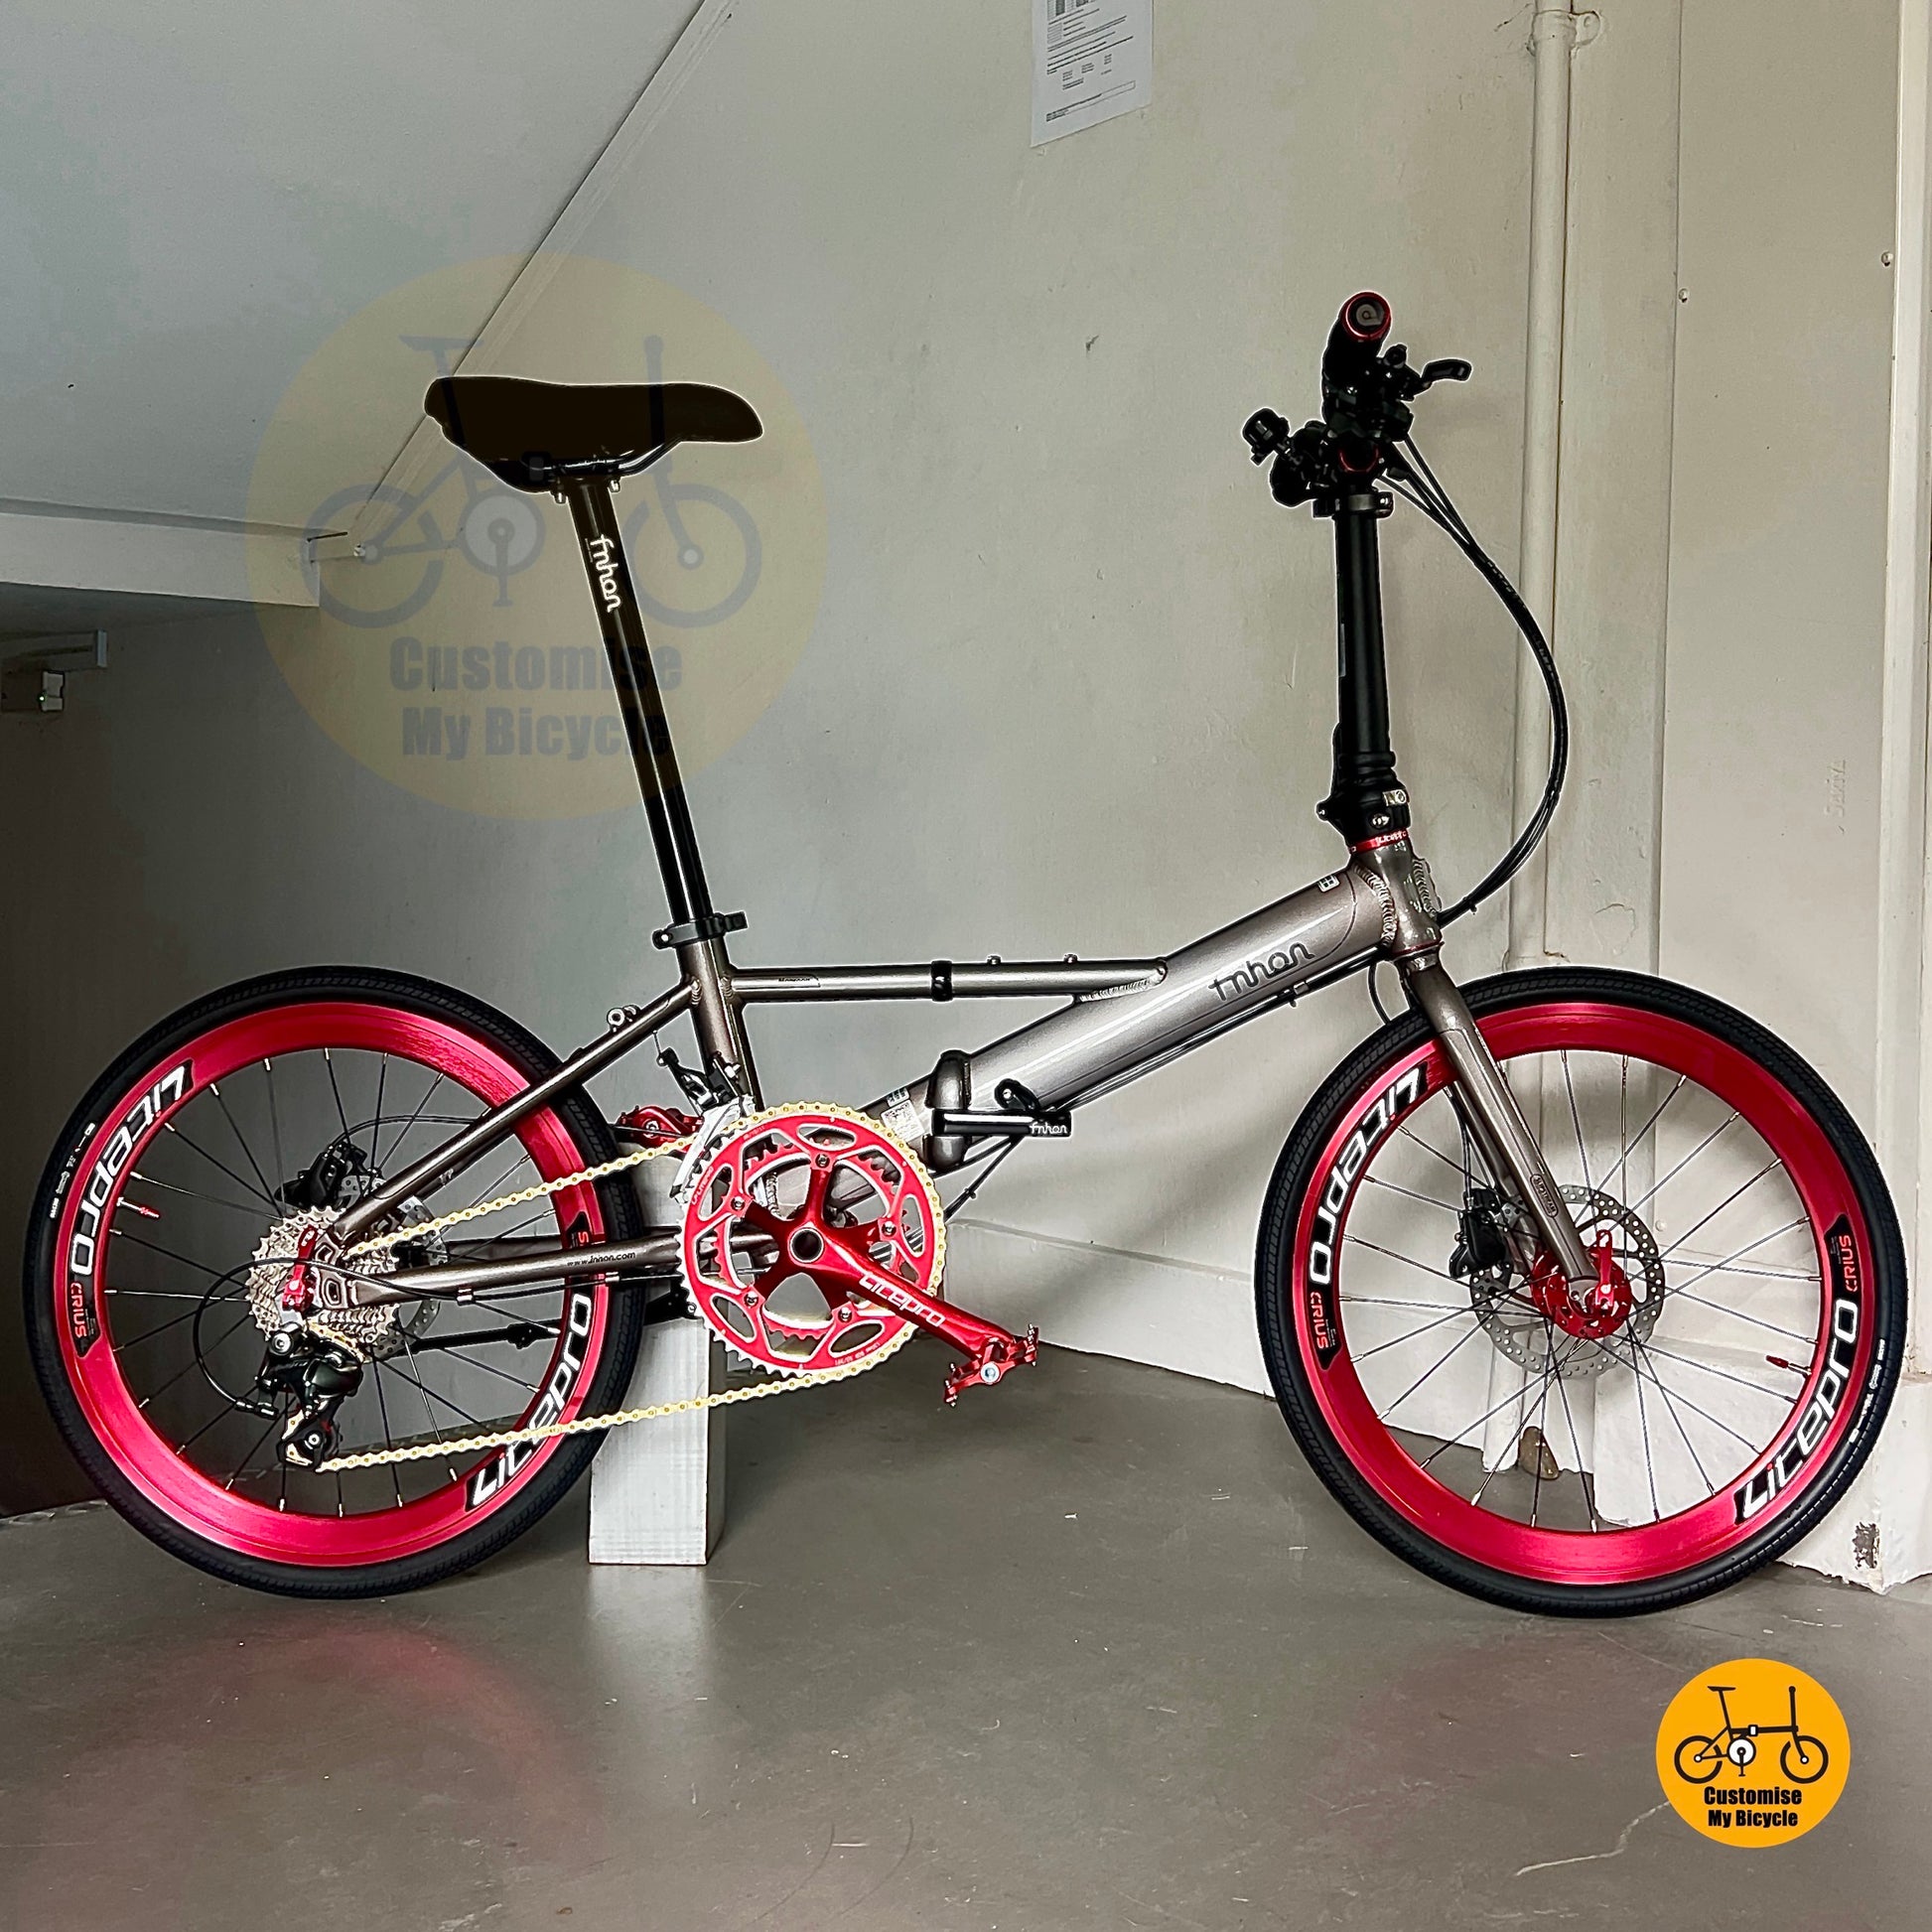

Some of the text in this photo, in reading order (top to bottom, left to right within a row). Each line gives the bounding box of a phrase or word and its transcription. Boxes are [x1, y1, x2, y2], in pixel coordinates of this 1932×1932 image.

[1839, 1235, 1858, 1293] CRIUS
[70, 1282, 87, 1338] CRIUS
[1310, 1292, 1329, 1349] CRIUS
